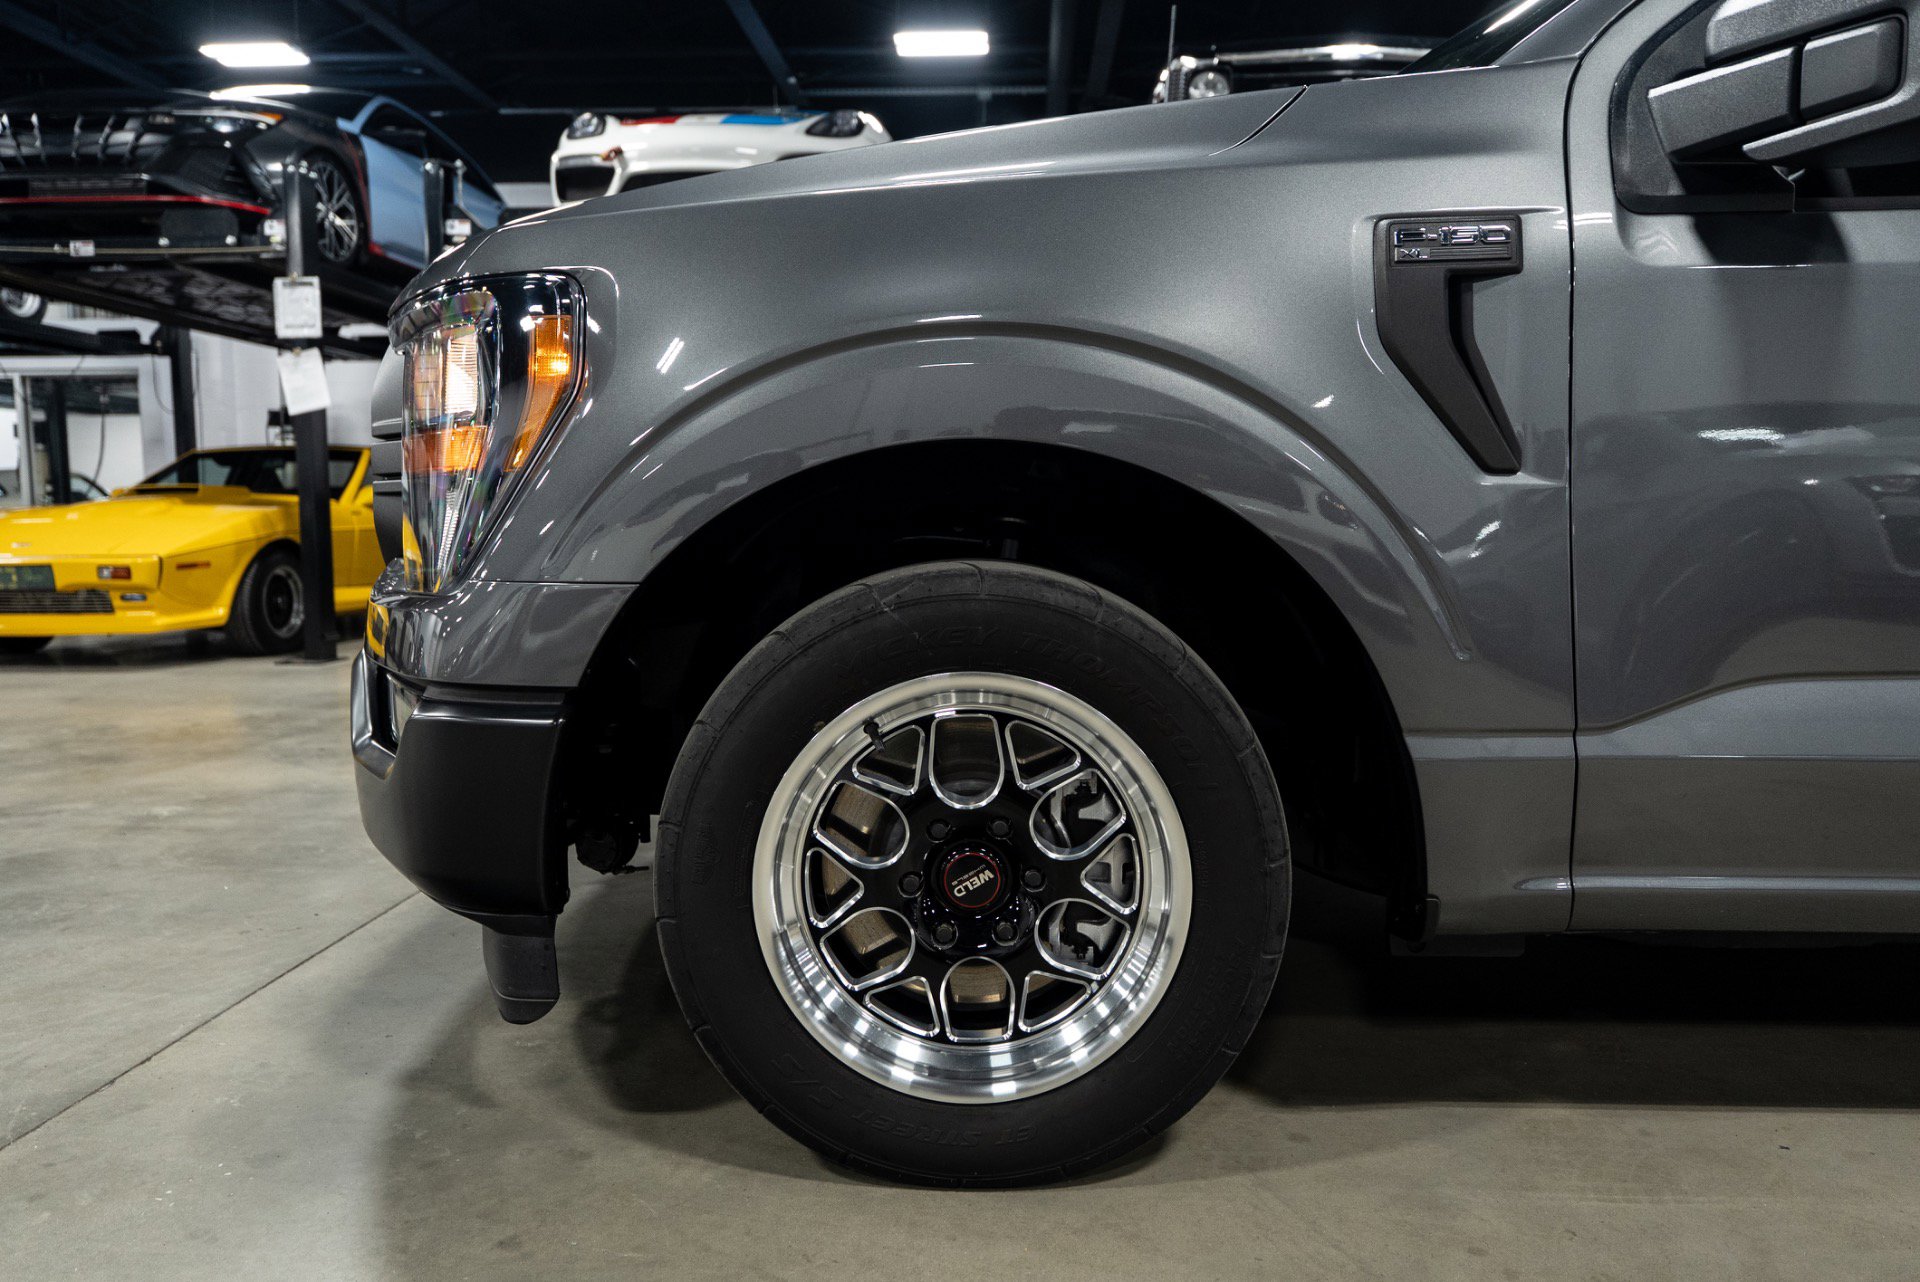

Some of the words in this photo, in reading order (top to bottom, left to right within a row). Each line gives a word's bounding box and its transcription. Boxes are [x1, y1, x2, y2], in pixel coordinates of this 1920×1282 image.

[1394, 225, 1513, 246] F-150
[1400, 248, 1429, 260] XL
[831, 627, 997, 679] MICKEY
[1023, 636, 1216, 794] THOMPSON
[953, 869, 995, 897] WELD
[851, 1106, 982, 1147] STREET
[997, 1124, 1038, 1146] ET
